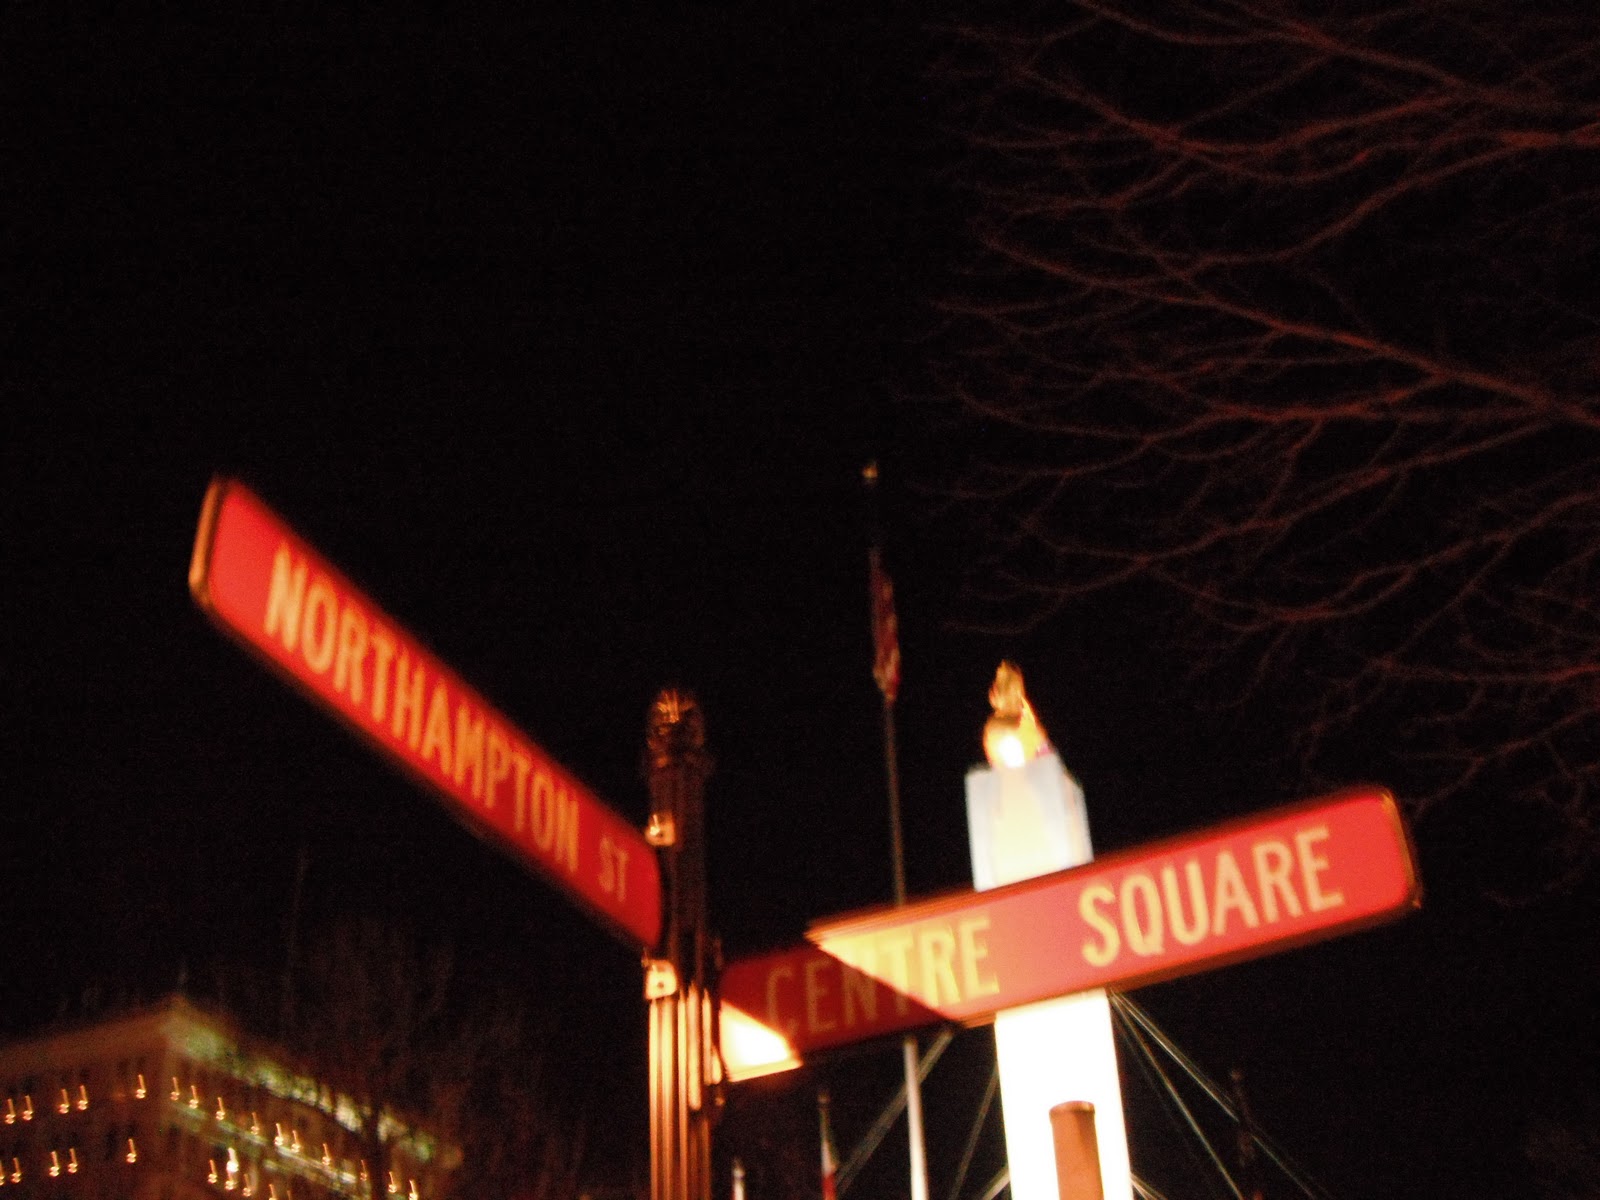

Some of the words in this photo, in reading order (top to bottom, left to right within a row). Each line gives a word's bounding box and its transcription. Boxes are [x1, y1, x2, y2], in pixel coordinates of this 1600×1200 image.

[264, 542, 580, 873] NORTHAMPTON
[599, 837, 629, 902] ST
[765, 914, 1001, 1037] CENTRE
[1078, 826, 1345, 968] SQUARE
